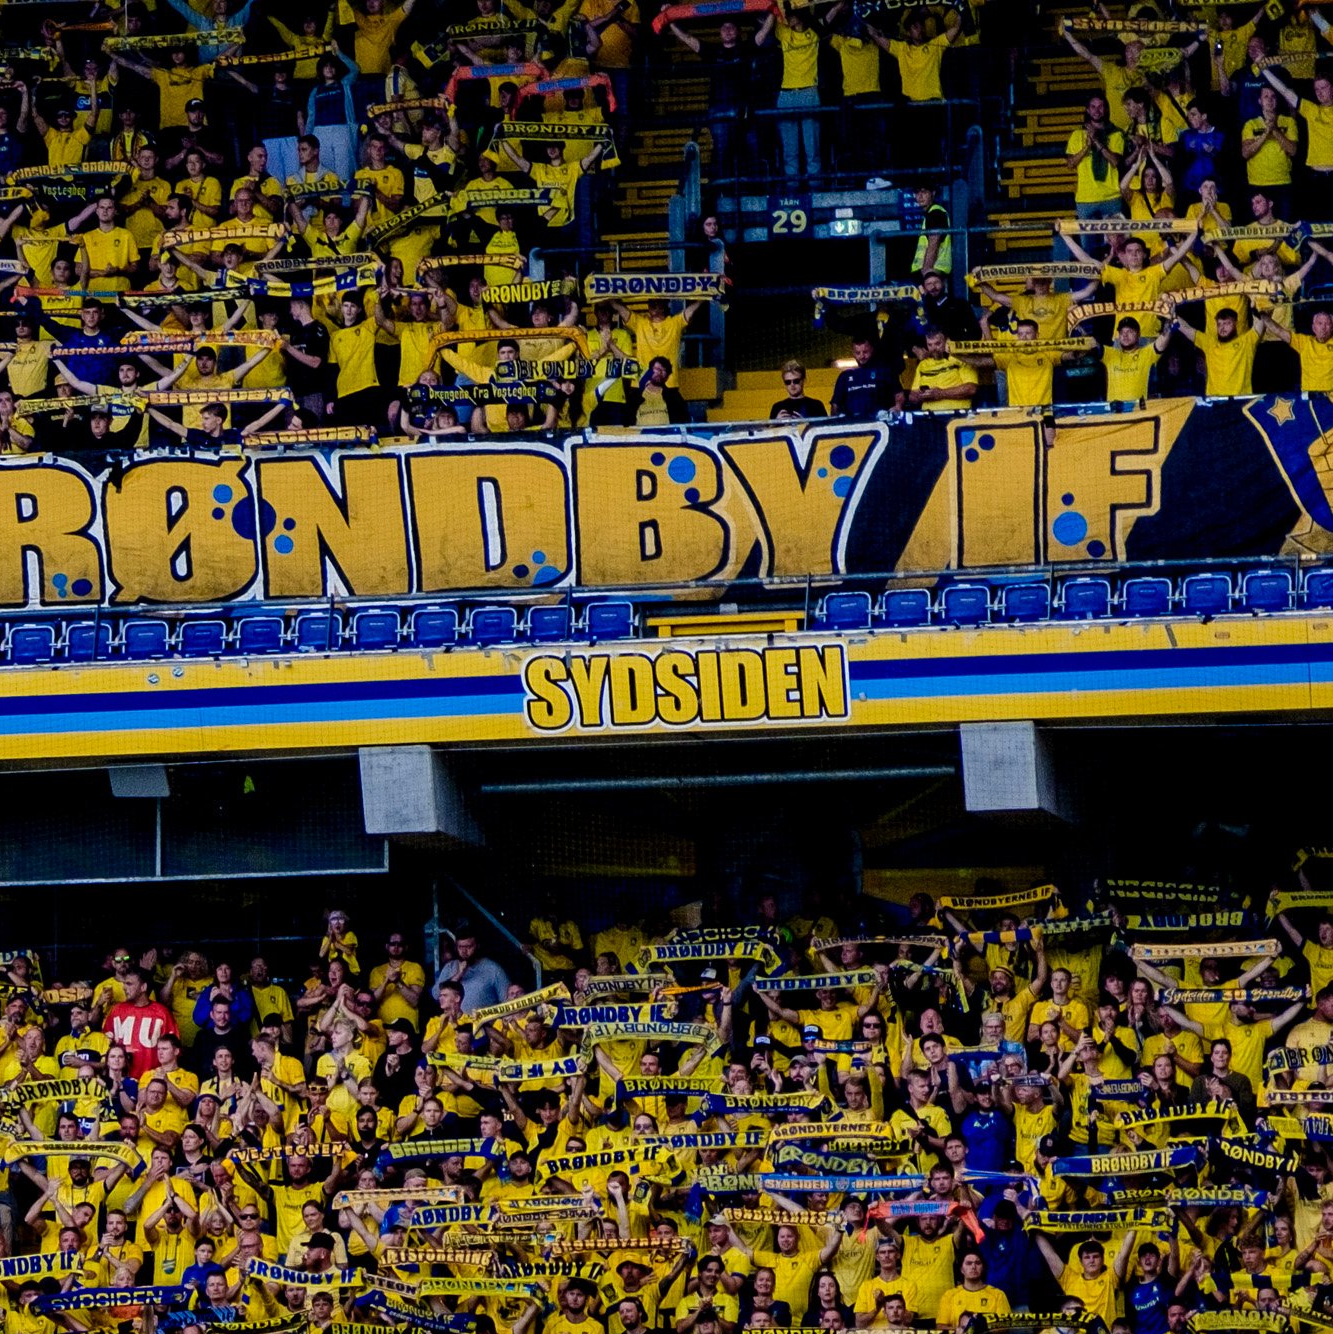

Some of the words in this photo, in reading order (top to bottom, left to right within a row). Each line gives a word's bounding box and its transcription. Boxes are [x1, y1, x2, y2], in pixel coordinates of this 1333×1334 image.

[771, 209, 807, 233] 29
[953, 418, 1162, 566] IF
[526, 645, 846, 726] SYDSIDEN
[111, 1013, 163, 1048] MU
